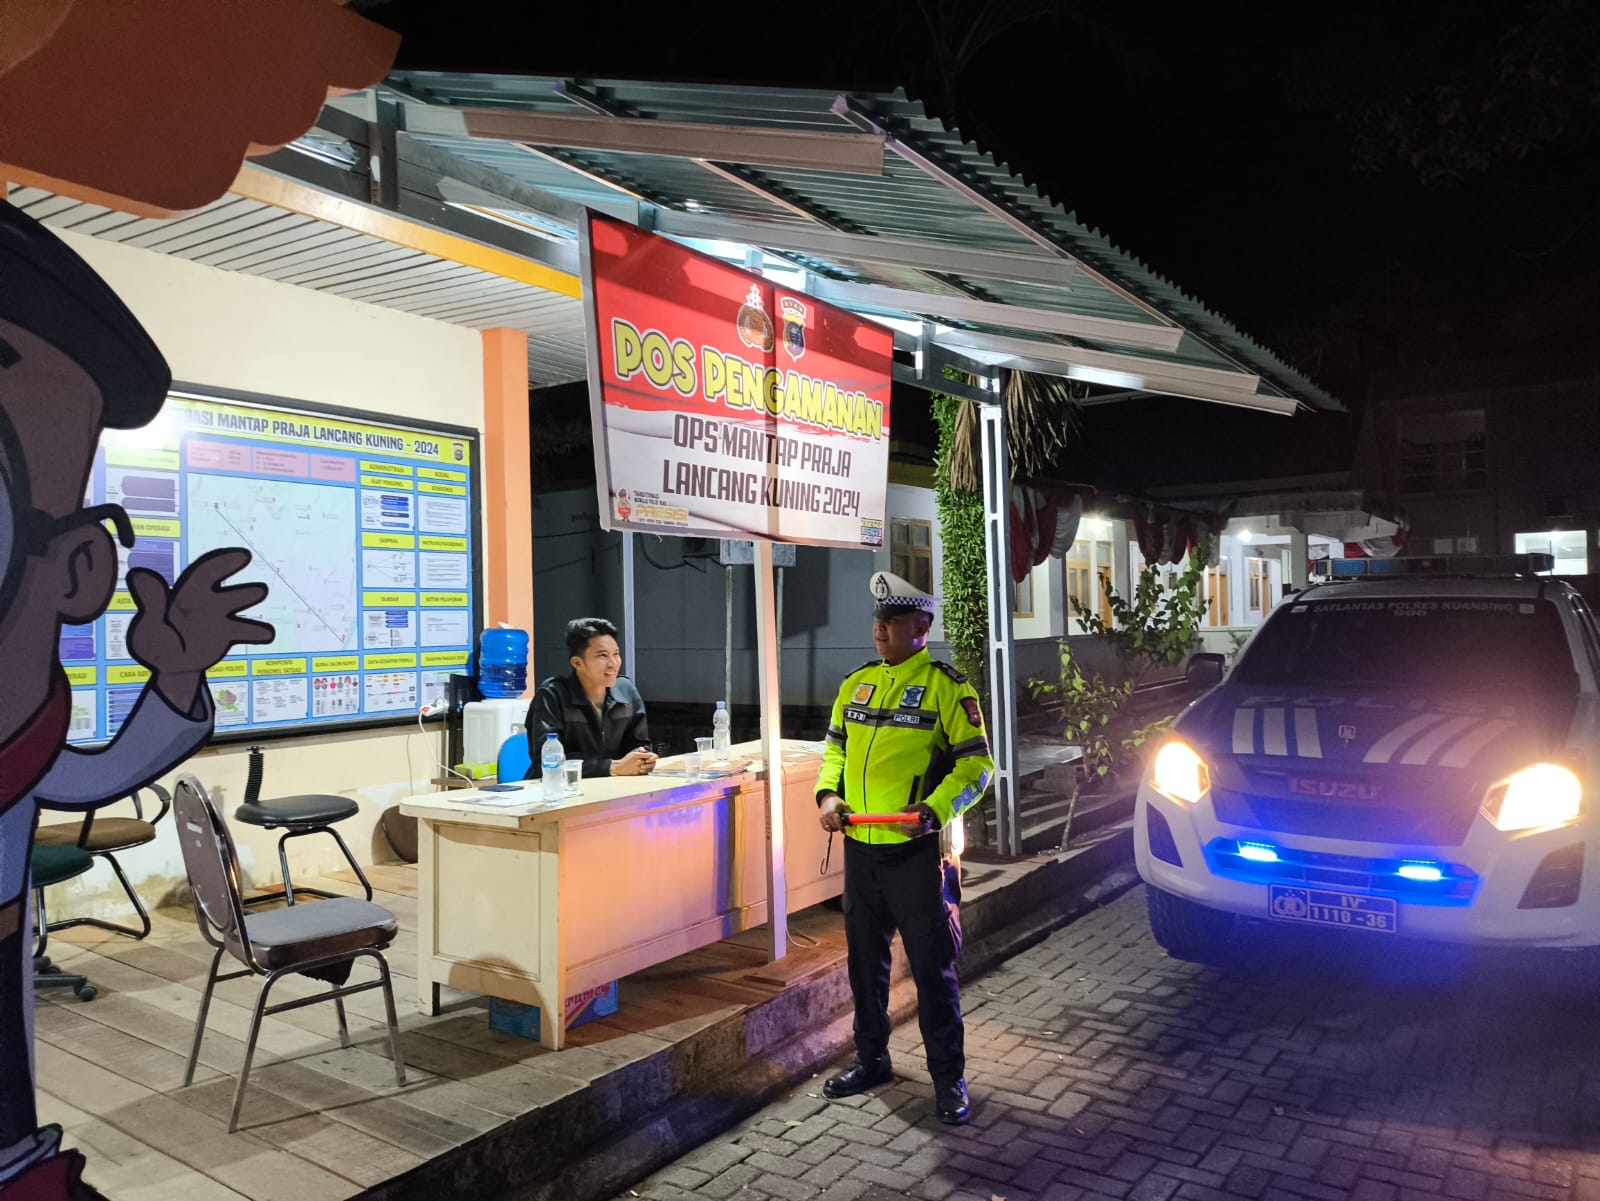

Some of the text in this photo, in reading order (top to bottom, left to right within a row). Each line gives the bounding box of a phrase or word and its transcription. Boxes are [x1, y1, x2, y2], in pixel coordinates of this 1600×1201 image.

[612, 318, 883, 440] POS PENGAMANAN
[218, 413, 268, 432] MANTAP
[272, 420, 310, 439] PRAJA
[313, 426, 362, 445] LANCANG
[366, 433, 403, 451] KUNING
[414, 441, 439, 455] 2024
[673, 413, 851, 478] OPS MANTAP PRAJA
[663, 459, 860, 518] LANCANG KUNING 2024
[895, 713, 919, 725] POLRI
[1291, 777, 1378, 800] ISUZU
